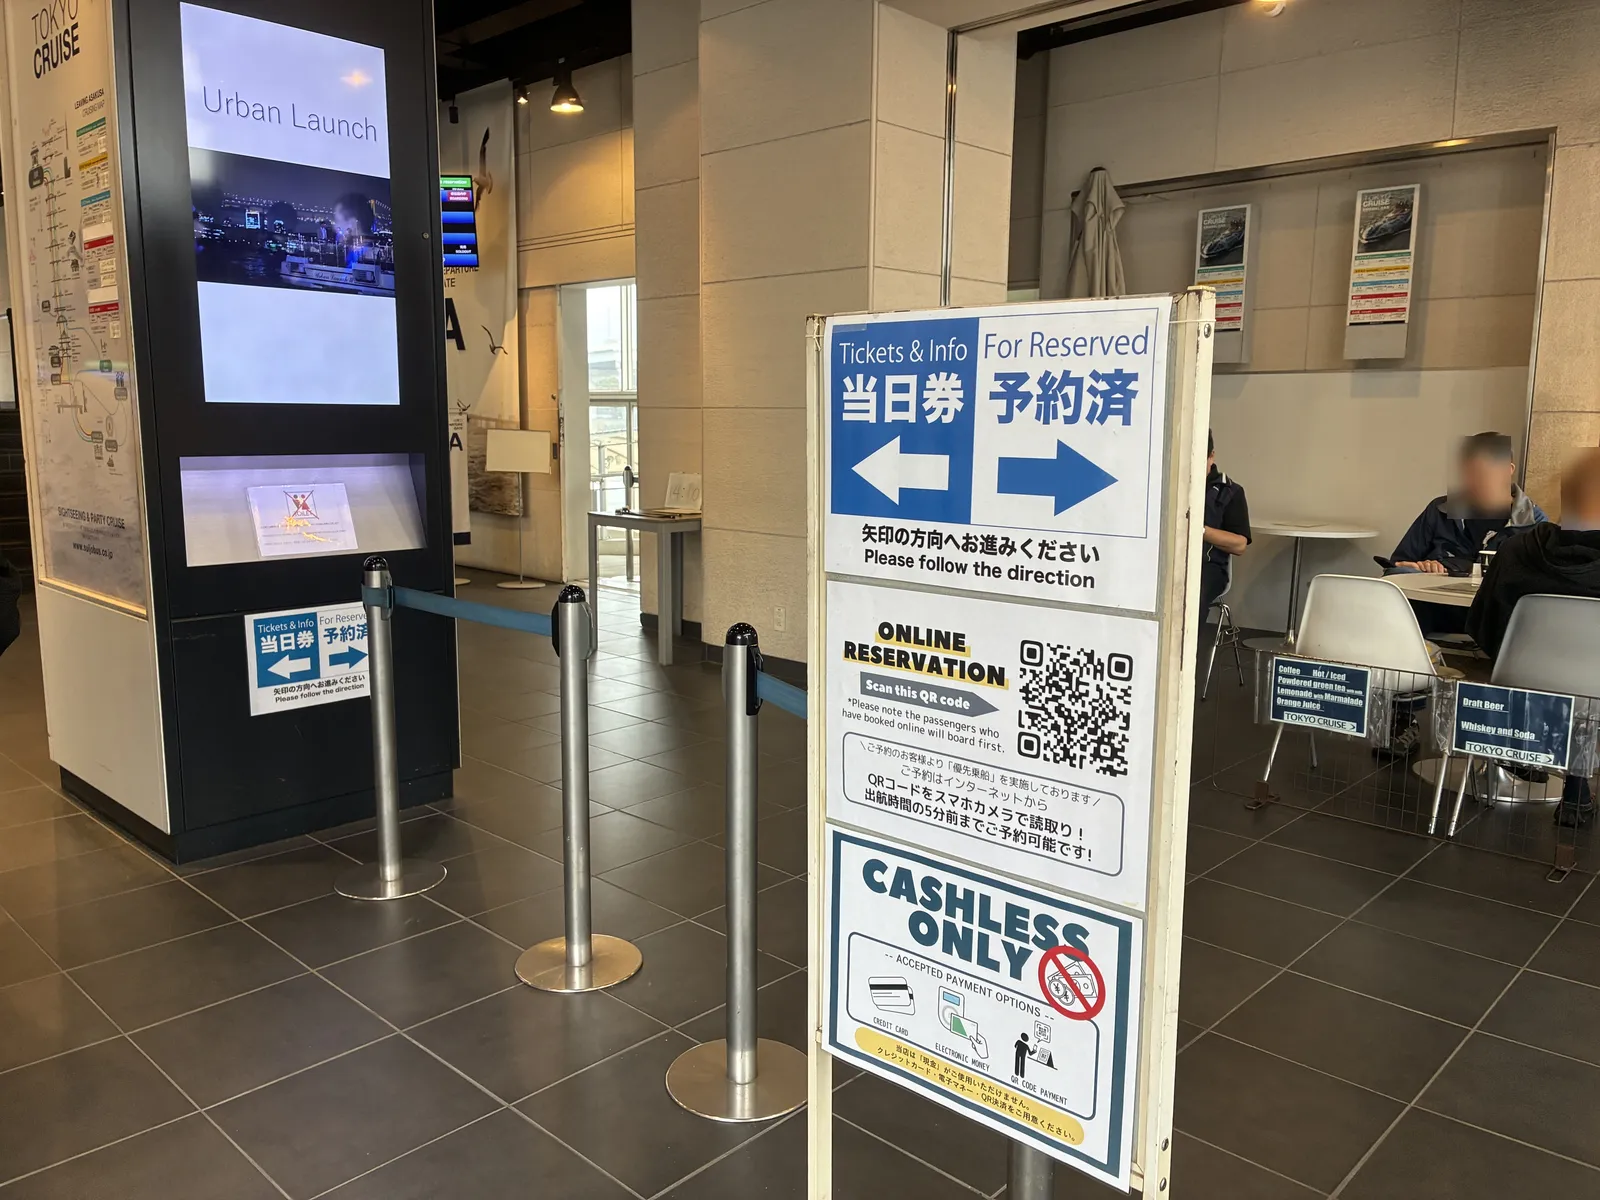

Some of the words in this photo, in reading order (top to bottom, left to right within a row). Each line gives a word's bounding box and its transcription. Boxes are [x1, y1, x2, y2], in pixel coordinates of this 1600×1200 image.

[31, 0, 79, 45] TOKYO
[33, 22, 80, 79] CRUISE
[203, 85, 281, 124] Urban
[291, 103, 377, 142] Launch
[444, 297, 466, 351] A
[839, 341, 904, 365] Tickets
[909, 338, 924, 363] &
[929, 336, 968, 362] Info
[984, 332, 1023, 360] For
[1029, 325, 1149, 358] Reserved
[841, 371, 965, 424] 当日券
[989, 368, 1139, 427] 予約済
[449, 432, 463, 452] A
[57, 506, 86, 521] SIGHTSEEING
[90, 512, 106, 526] PARTY
[106, 515, 126, 530] CRUISE
[861, 523, 1101, 564] 矢印の方向へお進みください
[864, 548, 915, 569] Please
[918, 553, 968, 576] follow
[972, 560, 1002, 579] the
[1006, 563, 1096, 589] direction
[257, 622, 288, 634] Tickets
[289, 621, 296, 630] &
[297, 618, 315, 629] Info
[319, 615, 334, 625] For
[323, 622, 368, 645] 予約済
[260, 630, 315, 654] 当日券
[877, 621, 966, 653] ONLINE
[843, 640, 1006, 687] RESERVATION
[1278, 664, 1301, 675] Coffee
[1312, 669, 1325, 677] Hot
[1330, 671, 1346, 681] Iced
[273, 674, 366, 696] 矢印の方向へお進みください
[275, 693, 299, 703] Please
[300, 690, 321, 699] follow
[322, 687, 334, 695] the
[335, 683, 365, 693] direction
[865, 679, 893, 695] Scan
[894, 685, 918, 699] this
[919, 689, 938, 704] QR
[939, 693, 971, 710] code
[1277, 675, 1312, 687] Powdered
[1312, 680, 1334, 690] green
[1334, 683, 1346, 691] tea
[1277, 686, 1313, 698] Lemonade
[1324, 692, 1363, 707] Marmalade
[1276, 696, 1302, 708] Orange
[1302, 700, 1321, 710] Juice
[1462, 697, 1484, 708] Draft
[1484, 700, 1505, 711] Beer
[842, 708, 862, 721] have
[864, 713, 895, 728] booked
[897, 721, 925, 735] online
[927, 728, 945, 739] will
[947, 729, 975, 746] board
[978, 737, 1005, 754] first.
[881, 704, 903, 718] note
[905, 709, 921, 721] the
[923, 715, 976, 734] passengers
[979, 725, 1000, 739] who
[1285, 712, 1316, 724] TOKYO
[1317, 717, 1347, 730] CRUISE
[1461, 720, 1497, 734] Whiskey
[1497, 726, 1513, 737] and
[1514, 728, 1536, 740] Soda
[1467, 742, 1504, 756] TOKYO
[1505, 748, 1541, 762] CRUISE
[900, 764, 1048, 812] ご予約はインターネットから
[862, 858, 1091, 962] CASHLESS
[908, 910, 1033, 982] ONLY
[896, 954, 943, 980] ACCEPTED
[946, 973, 994, 998] PAYMENT
[996, 991, 1041, 1018] OPTIONS
[873, 1016, 893, 1031] CREDIT
[895, 1024, 909, 1037] CARD
[935, 1042, 969, 1064] ELECTRONIC
[971, 1056, 991, 1072] MONEY
[1010, 1075, 1019, 1085] QR
[1021, 1080, 1037, 1093] CODE
[1040, 1087, 1068, 1106] PAYMENT
